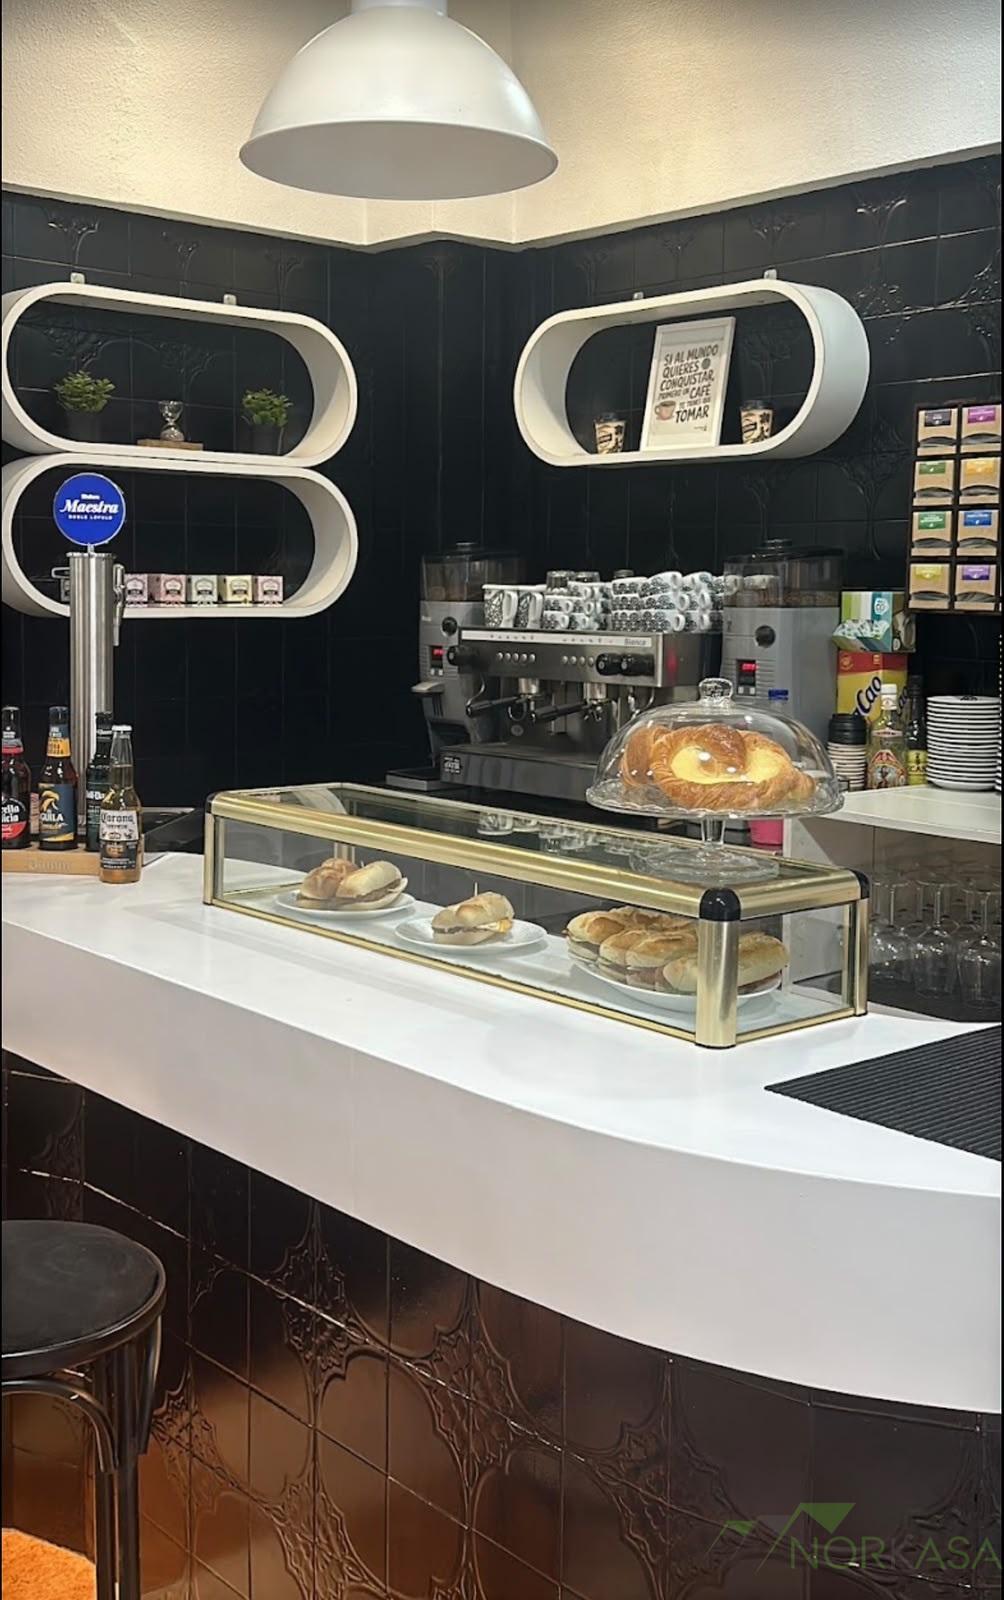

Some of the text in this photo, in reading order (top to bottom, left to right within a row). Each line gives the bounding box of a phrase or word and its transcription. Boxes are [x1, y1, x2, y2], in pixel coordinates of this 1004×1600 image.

[664, 344, 719, 366] SI AL MUNDO
[663, 360, 700, 378] QUIERES
[675, 404, 709, 423] TOMAR
[59, 499, 119, 514] Maestra
[856, 676, 881, 715] Cao
